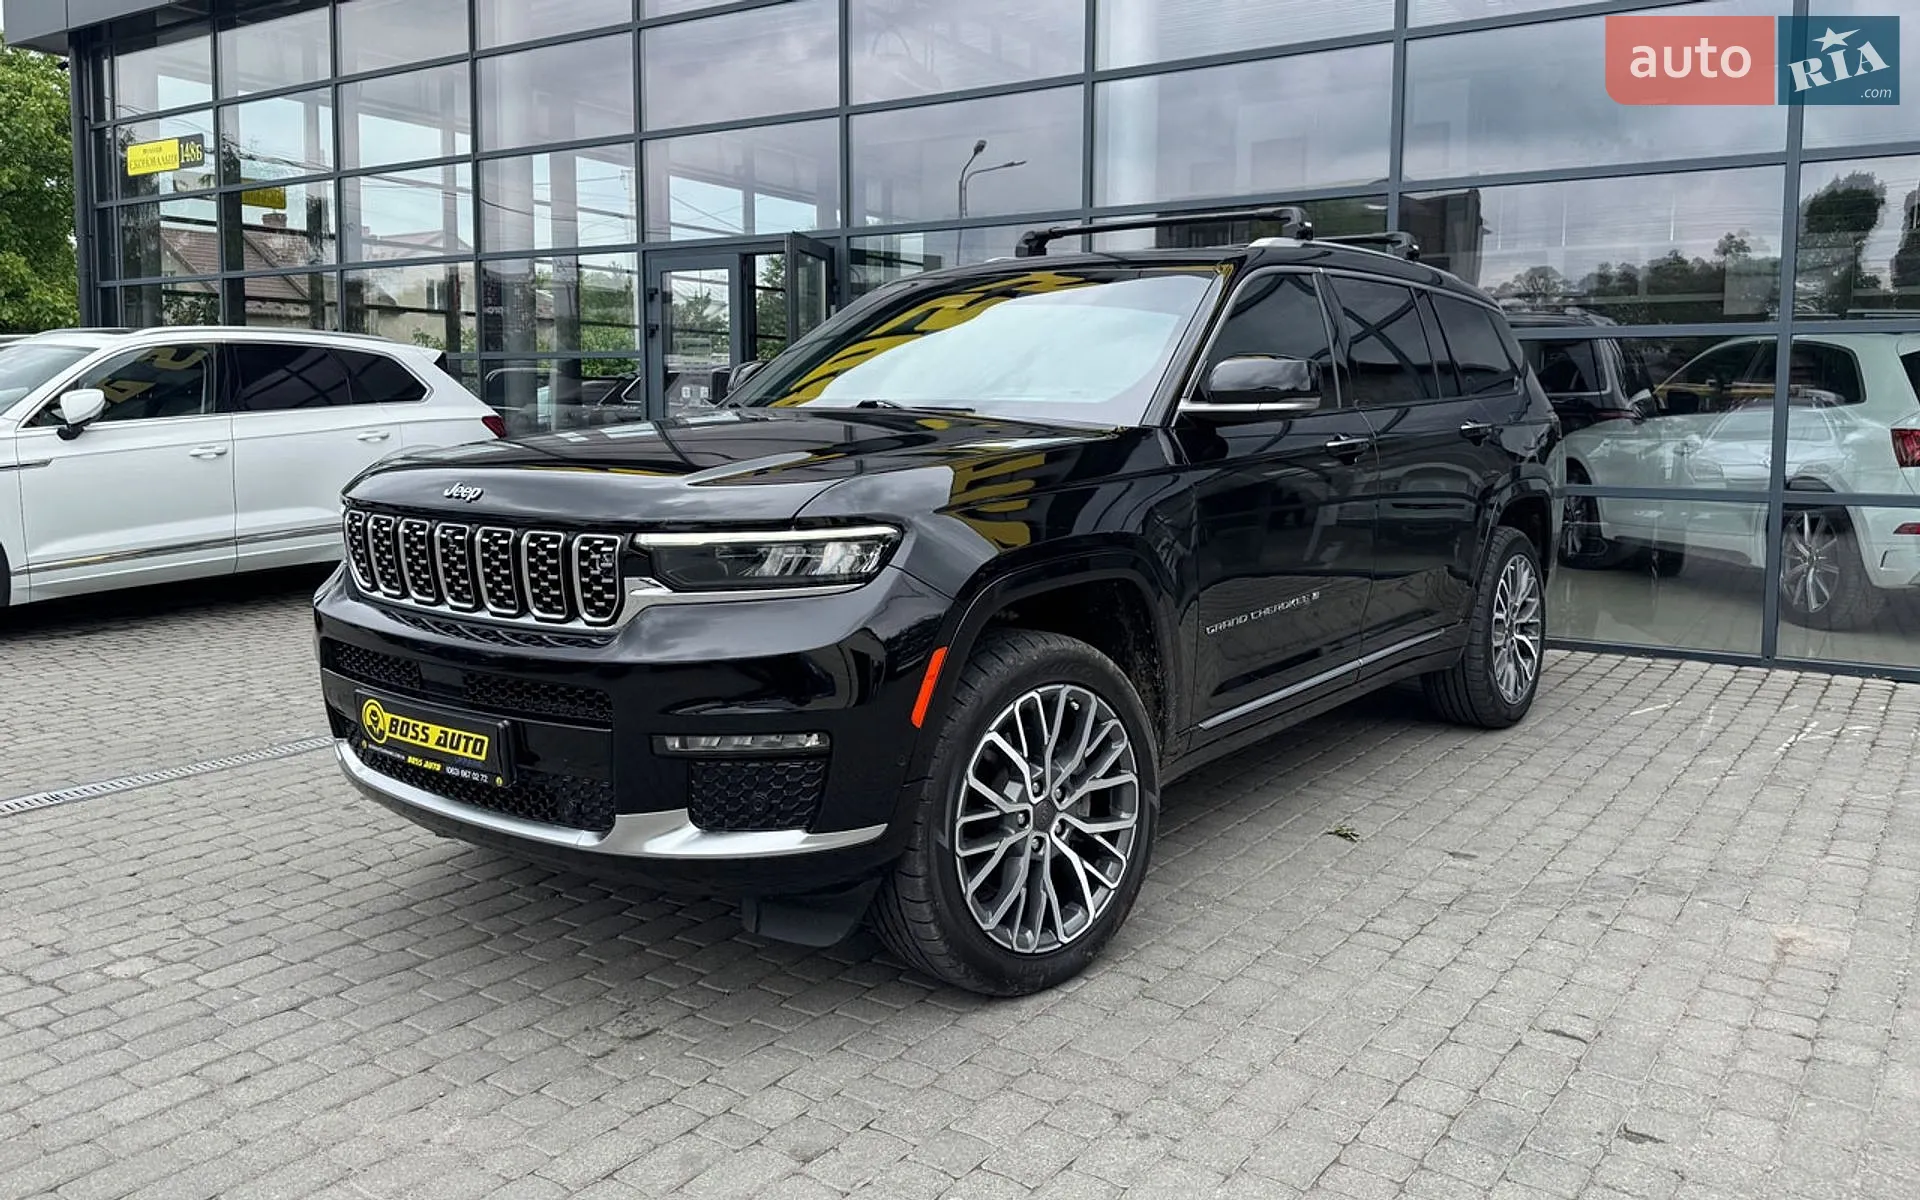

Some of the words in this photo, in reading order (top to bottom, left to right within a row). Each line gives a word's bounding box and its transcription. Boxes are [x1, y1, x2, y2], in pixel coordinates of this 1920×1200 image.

[443, 481, 484, 502] Jeep
[1205, 614, 1248, 635] GRAND
[388, 717, 431, 744] BOSS
[434, 730, 487, 756] AUTO
